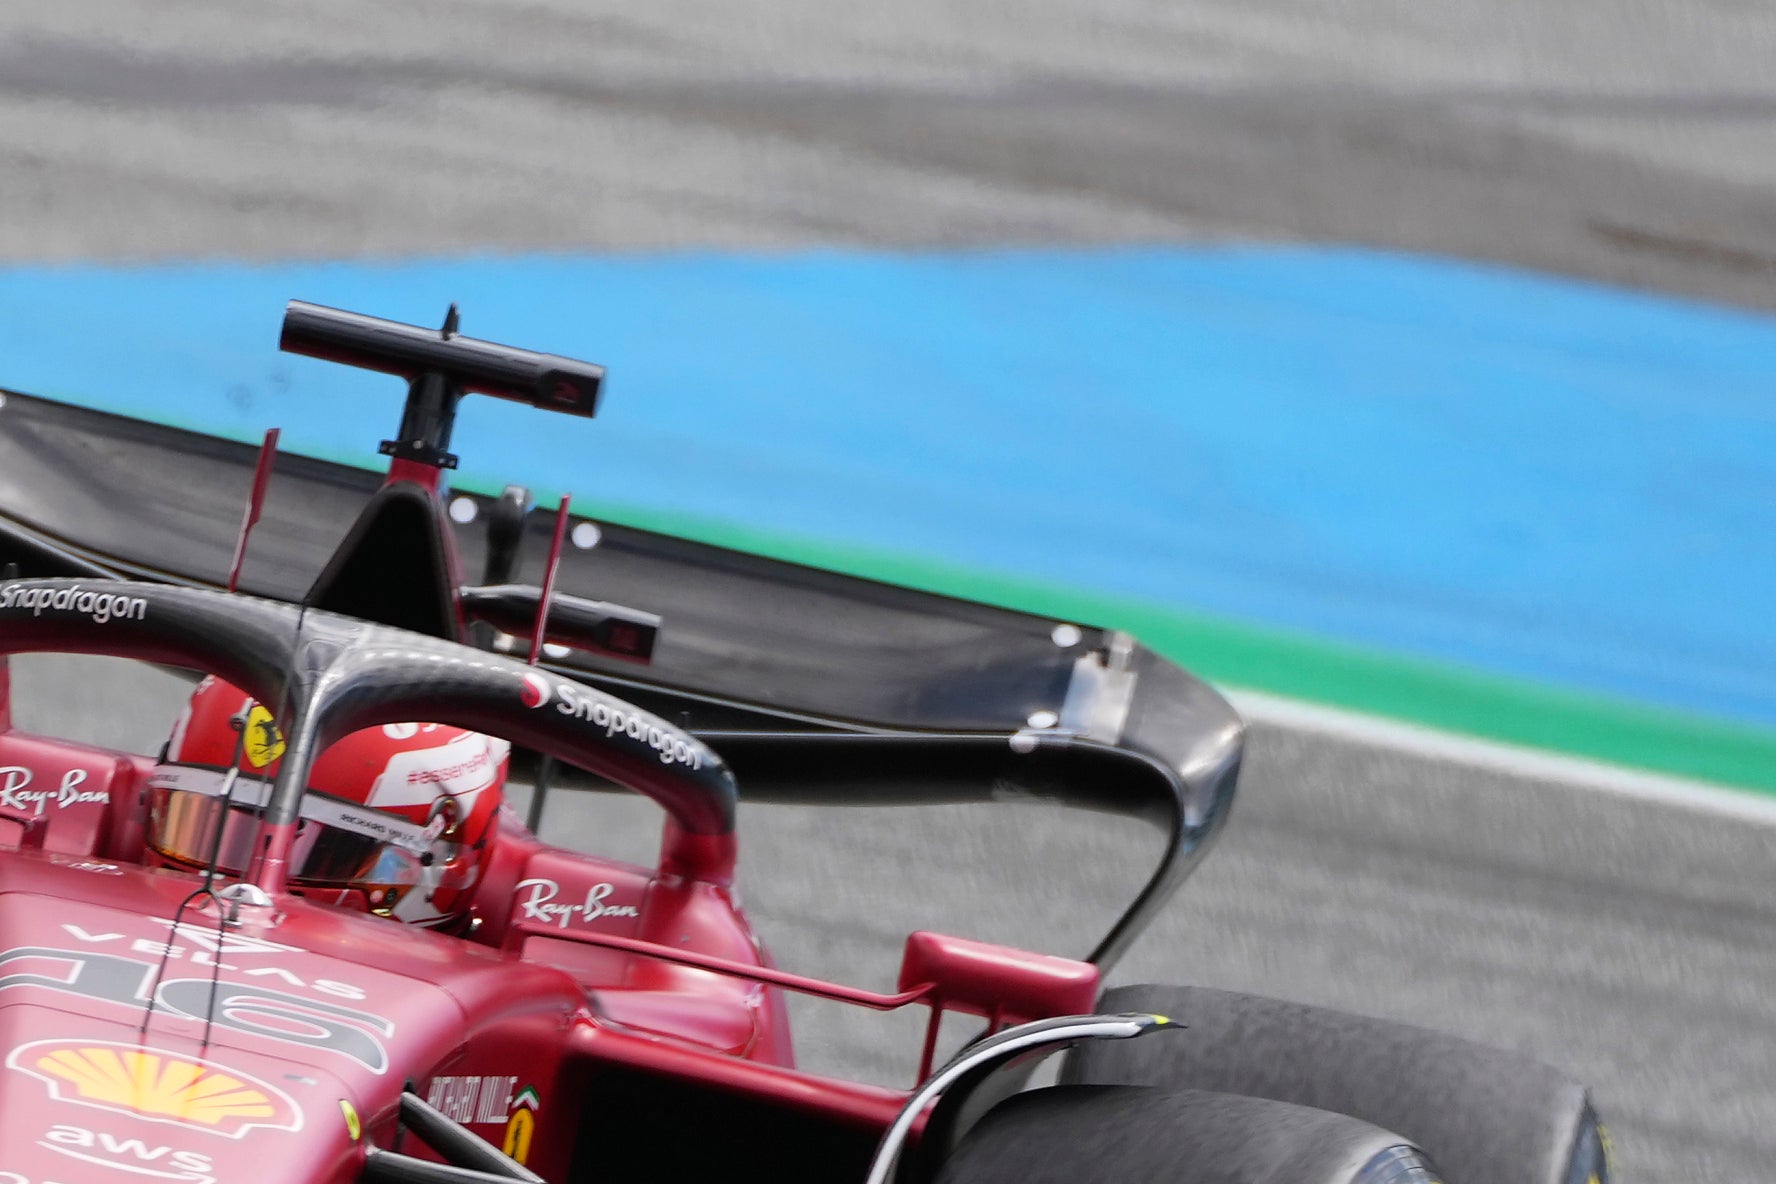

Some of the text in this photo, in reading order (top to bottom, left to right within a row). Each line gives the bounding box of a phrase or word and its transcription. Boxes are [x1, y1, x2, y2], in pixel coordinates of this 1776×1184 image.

[556, 684, 701, 771] Snapdragon
[515, 878, 639, 929] Ray-Ban
[61, 924, 368, 1000] VELAS
[46, 1124, 215, 1174] aws
